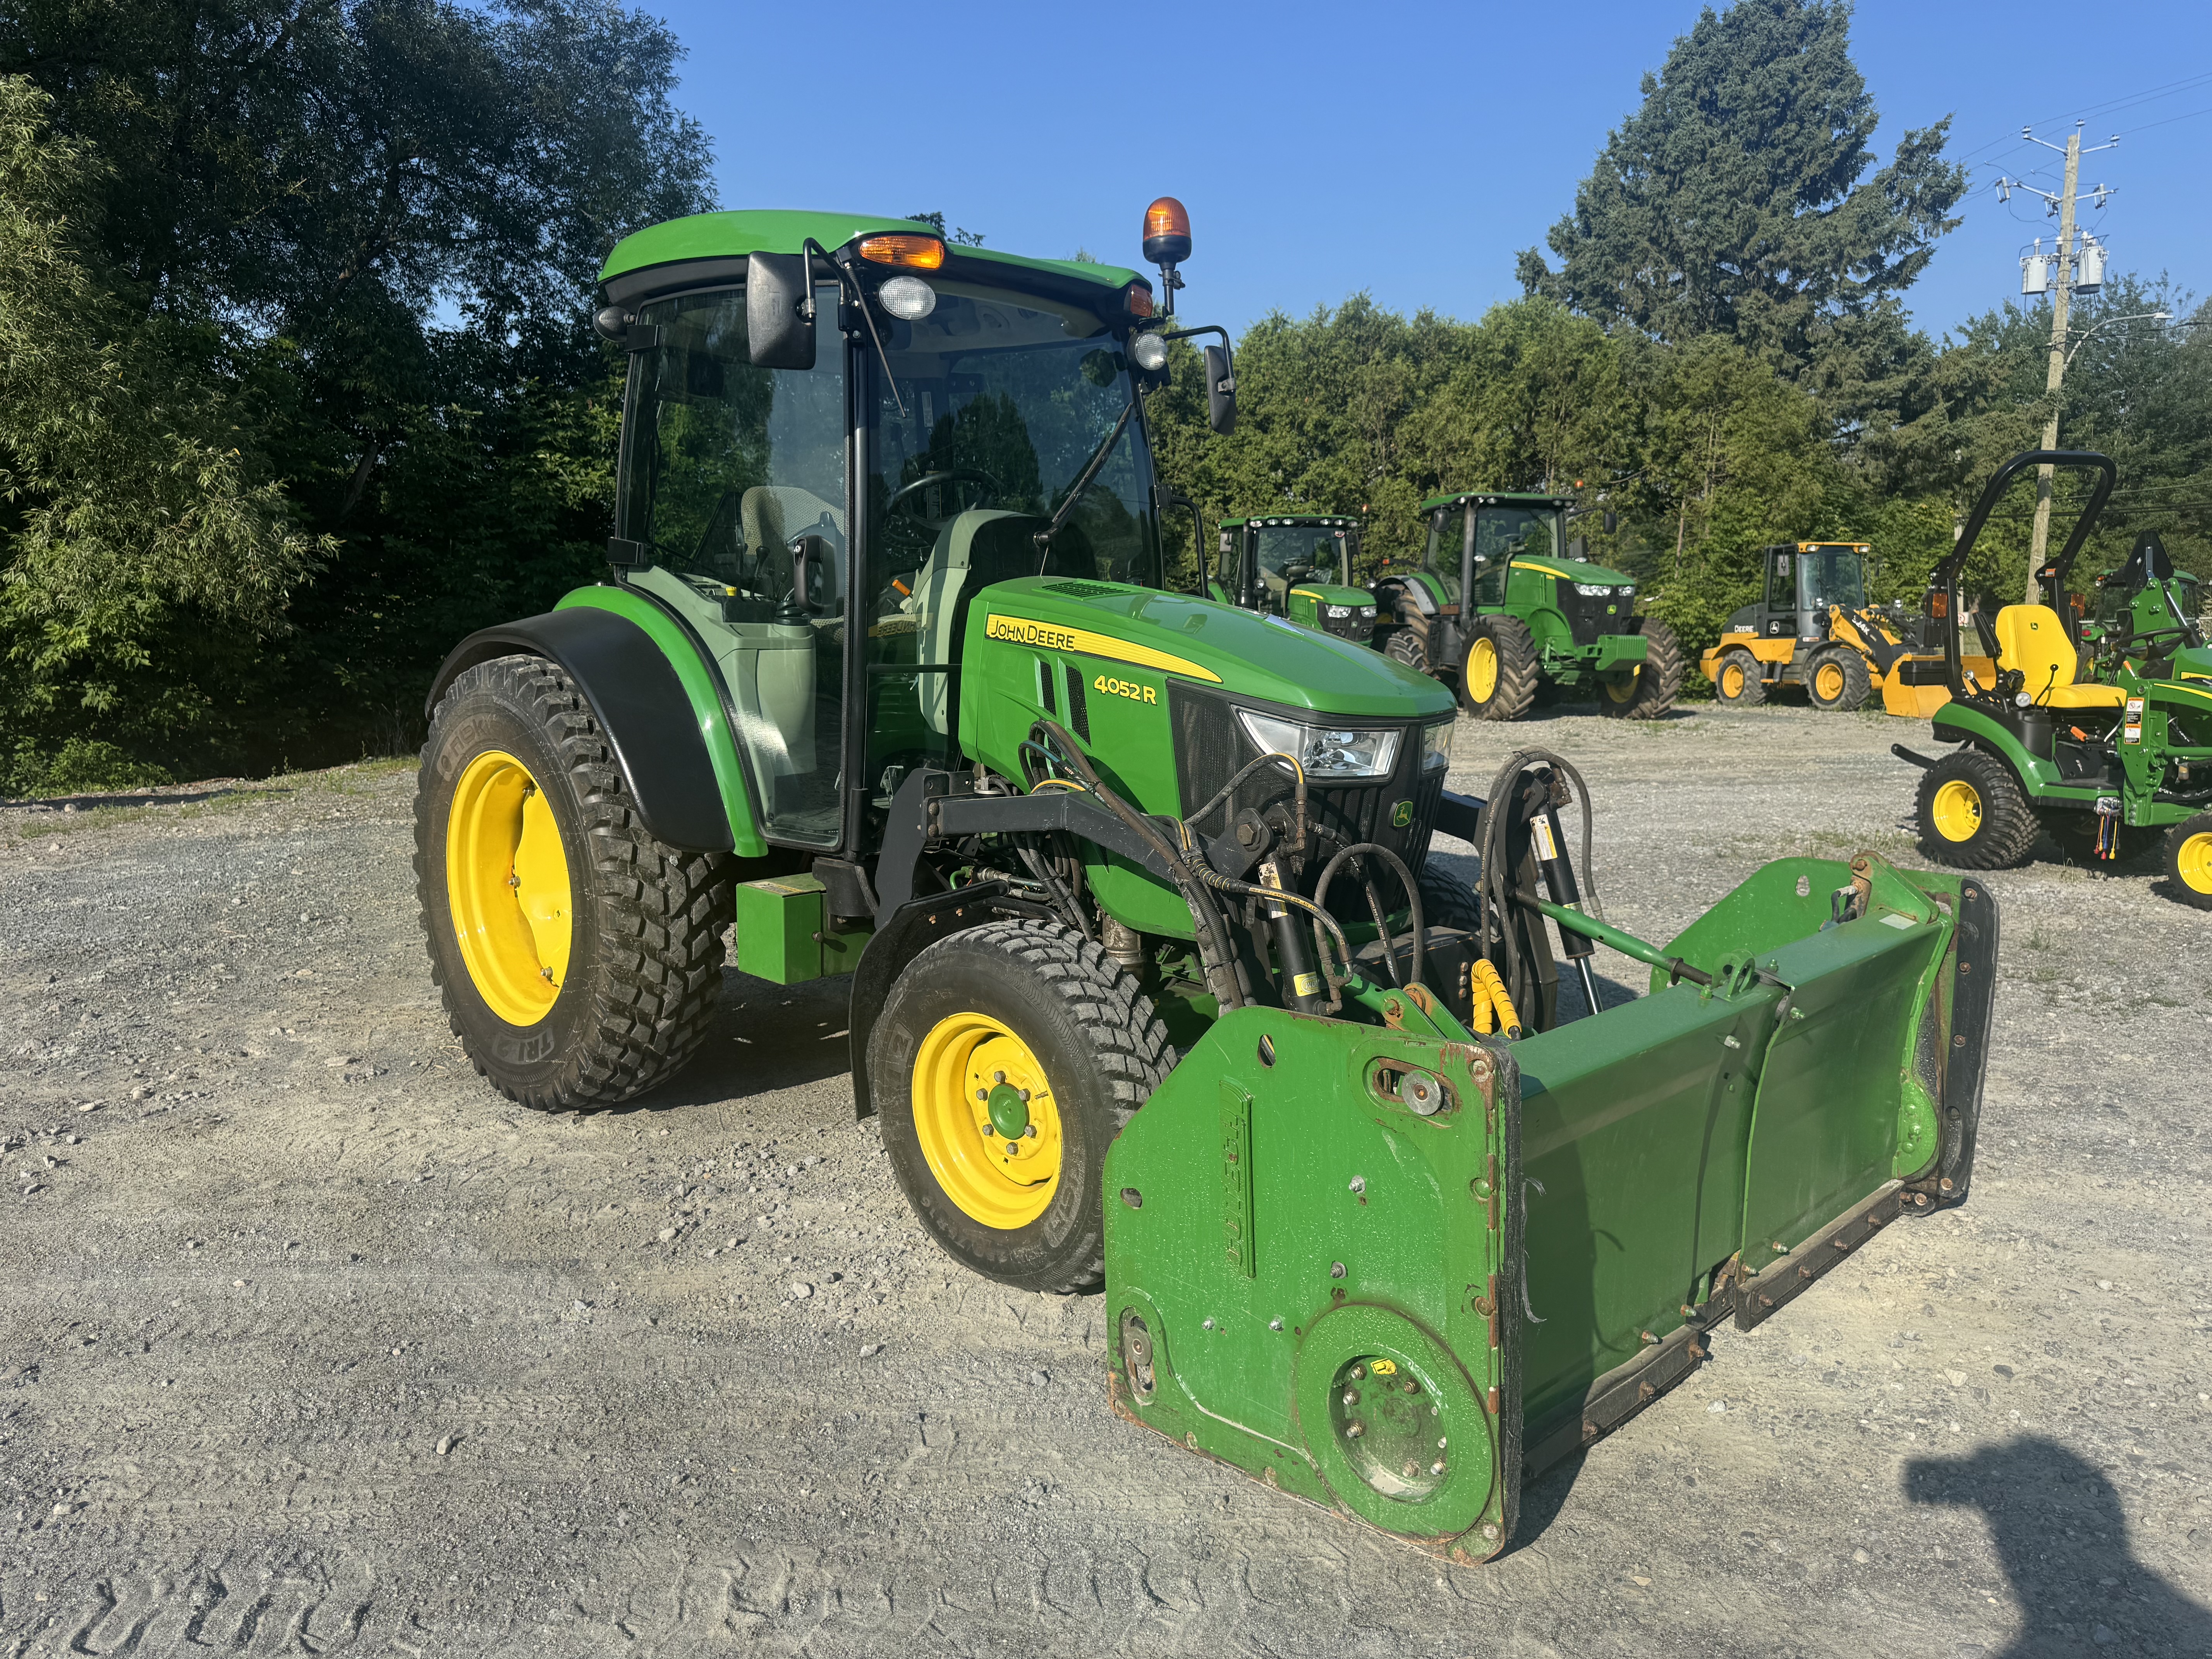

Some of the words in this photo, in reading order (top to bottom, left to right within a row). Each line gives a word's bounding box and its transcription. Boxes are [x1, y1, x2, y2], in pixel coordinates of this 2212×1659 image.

[991, 620, 1025, 640] JOHN
[1027, 625, 1075, 649] DEERE
[1735, 625, 1754, 633] DEERE
